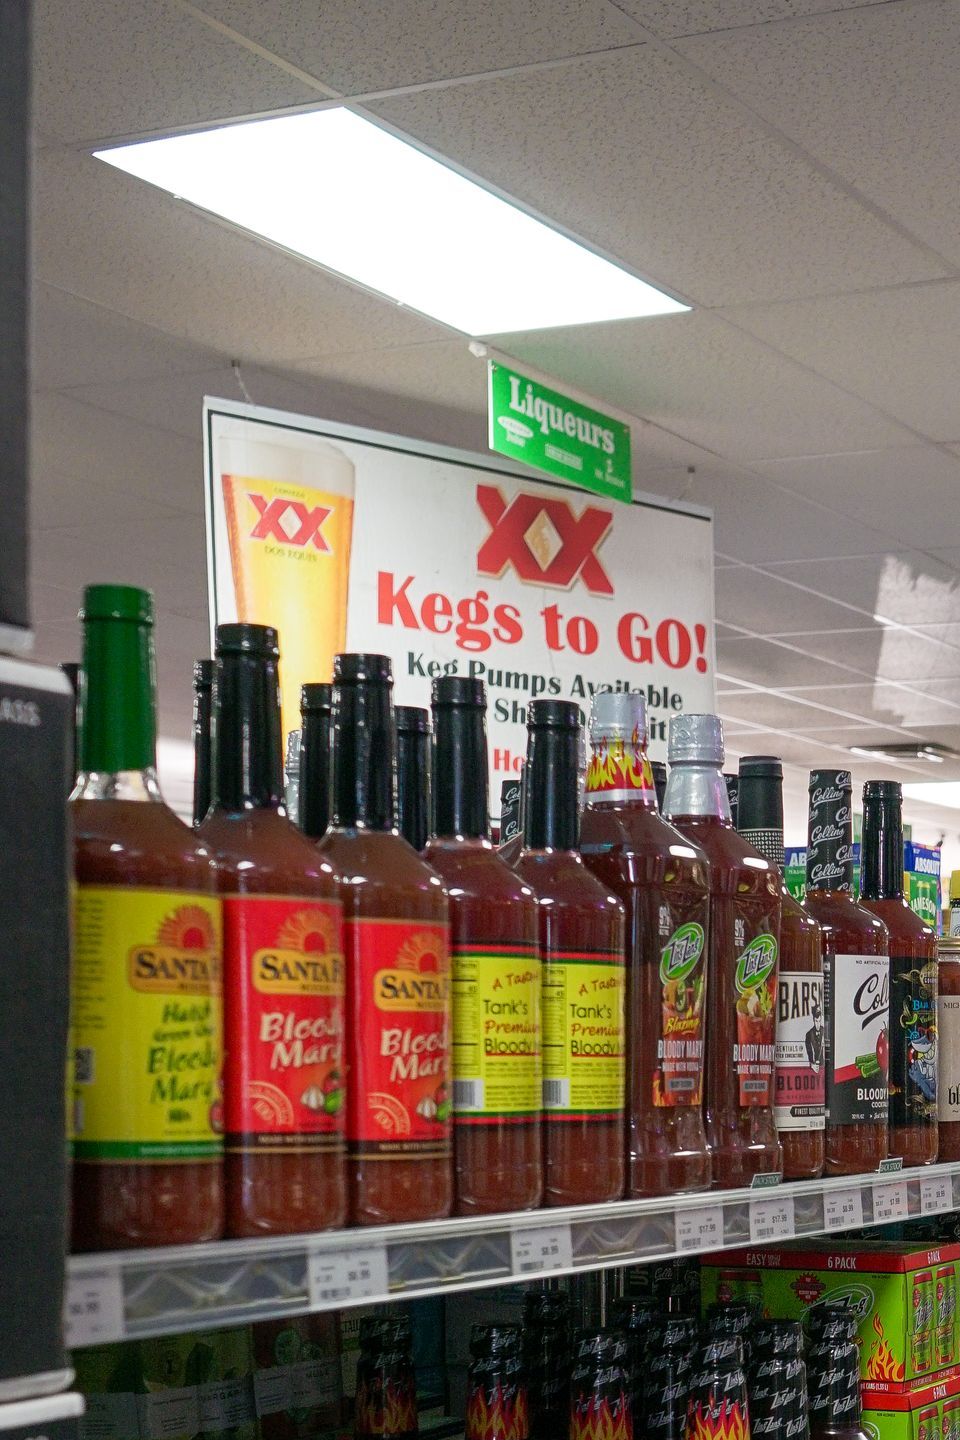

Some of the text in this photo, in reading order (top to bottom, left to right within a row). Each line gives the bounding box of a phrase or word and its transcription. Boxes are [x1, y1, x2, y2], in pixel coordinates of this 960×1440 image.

[509, 376, 615, 454] Liqueurs
[477, 484, 614, 598] XX
[377, 571, 708, 673] Kegs to GO!
[408, 651, 457, 677] Keg
[469, 660, 561, 697] Pumps
[812, 788, 844, 807] Collins
[811, 825, 845, 846] Collins
[811, 863, 845, 882] Collins
[735, 919, 745, 937] 9%
[135, 954, 208, 980] SANTA
[259, 956, 330, 982] SANTA
[380, 977, 444, 1000] SANTA
[492, 979, 502, 992] A
[579, 984, 589, 996] A
[485, 1000, 528, 1015] Tank's
[570, 1004, 613, 1019] Tank's
[485, 1038, 532, 1054] Bloody
[571, 1040, 615, 1055] Bloody
[658, 1040, 686, 1059] BLOODY
[733, 1044, 776, 1062] BLOODY MARY
[857, 1088, 887, 1101] BLOODY
[747, 1254, 766, 1266] EASY
[828, 1257, 857, 1269] 6 PACK
